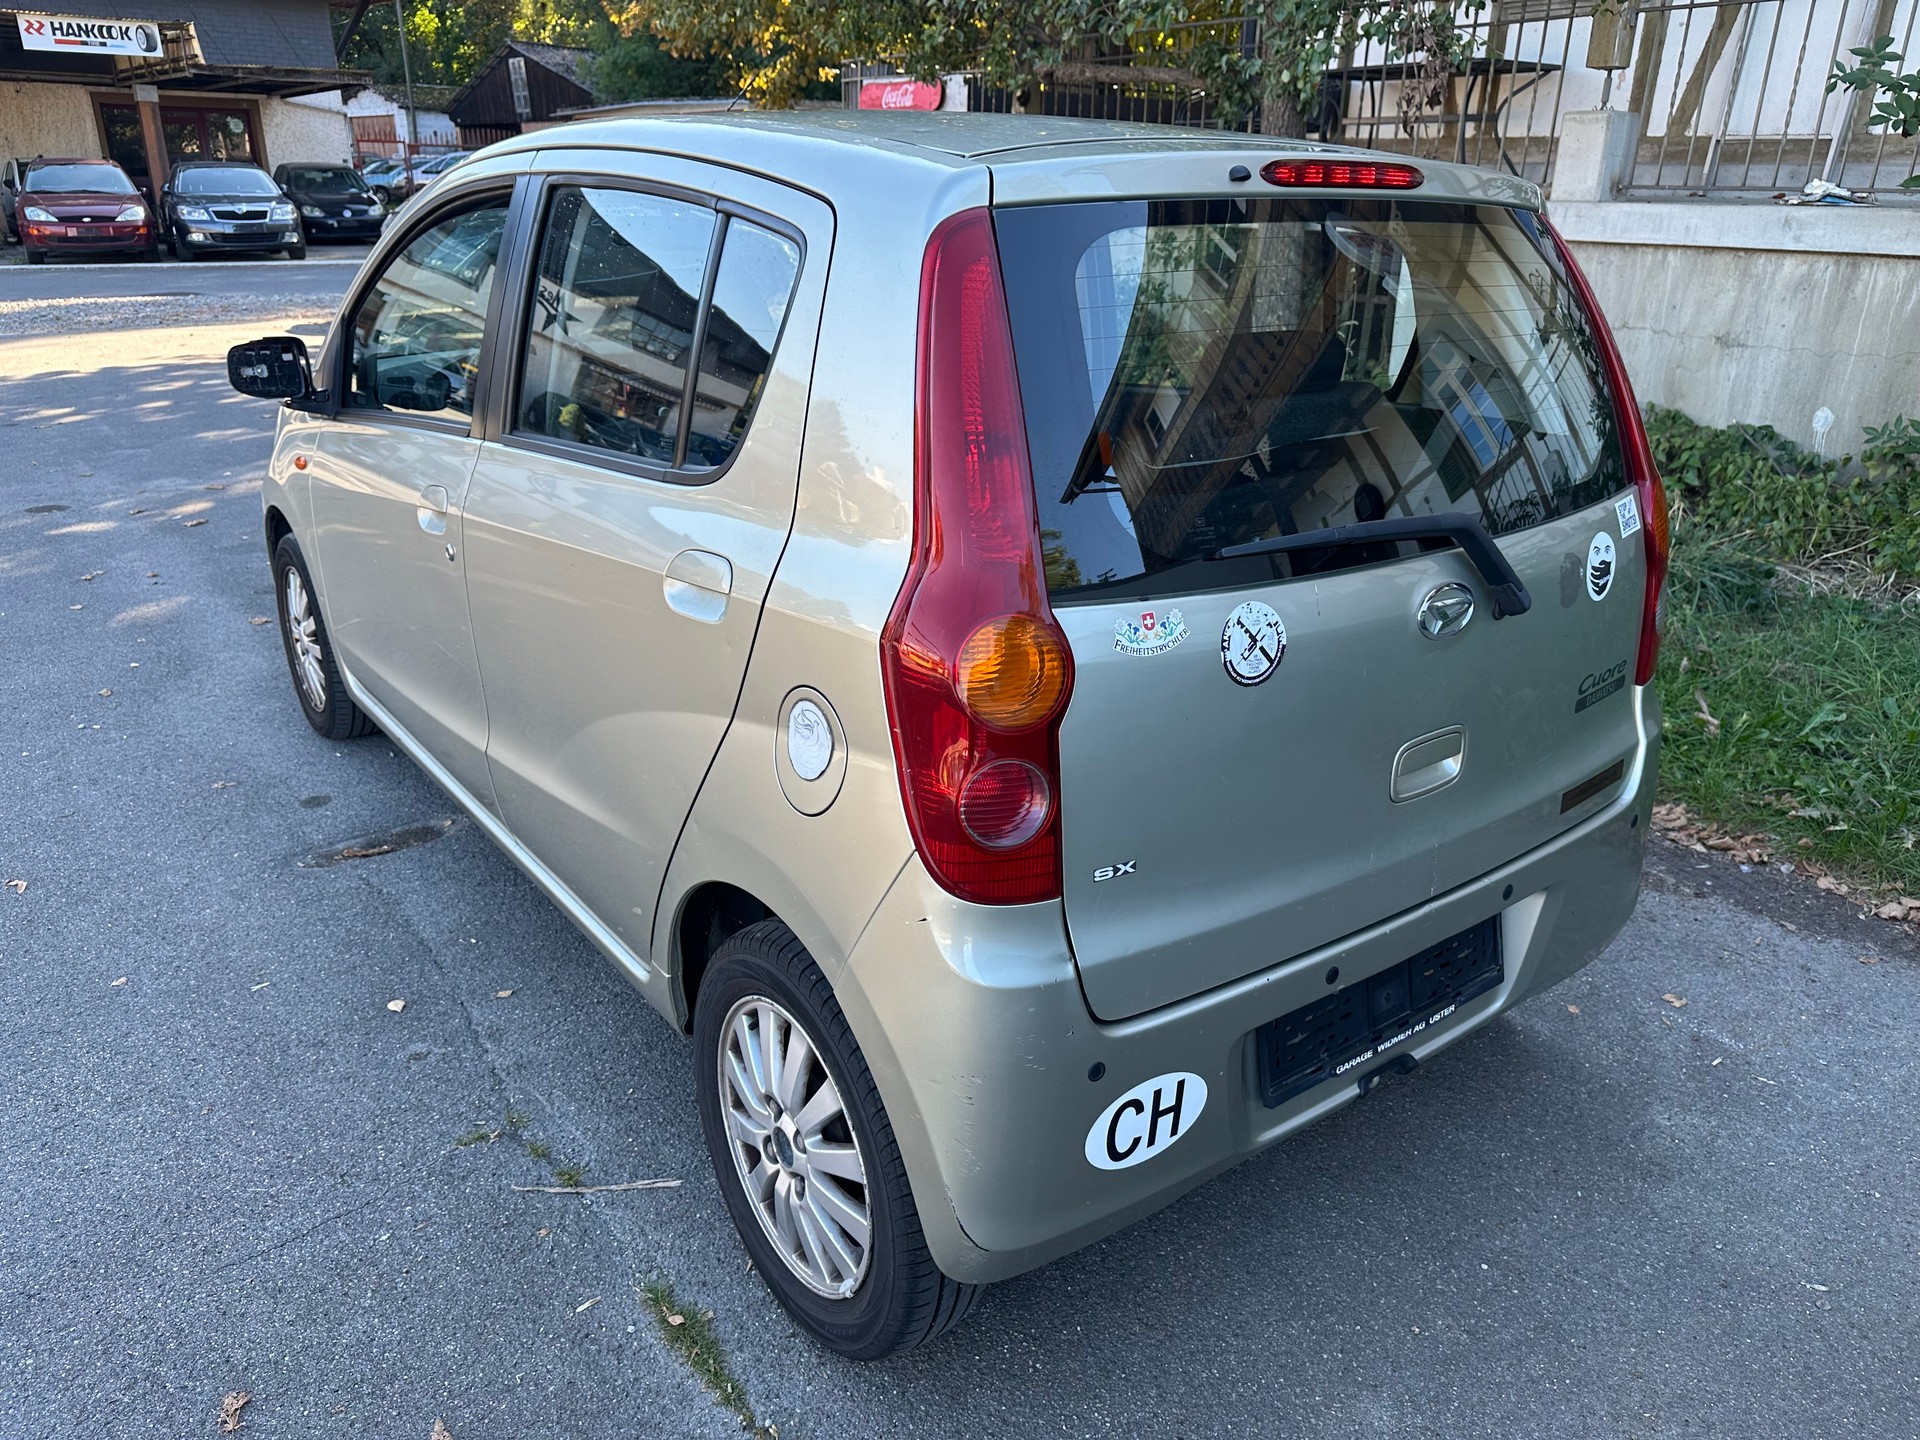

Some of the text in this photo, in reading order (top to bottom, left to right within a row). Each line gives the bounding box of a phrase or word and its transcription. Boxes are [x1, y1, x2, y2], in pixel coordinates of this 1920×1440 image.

[50, 21, 132, 41] HANKOOK
[1114, 628, 1189, 655] FREIHEITSTRYCHLER
[1578, 660, 1627, 695] Cuore
[1094, 860, 1136, 881] SX
[1336, 1049, 1374, 1074] GARAGE
[1413, 1021, 1426, 1033] AG
[1429, 1004, 1456, 1024] USTER
[1106, 1078, 1186, 1163] CH
